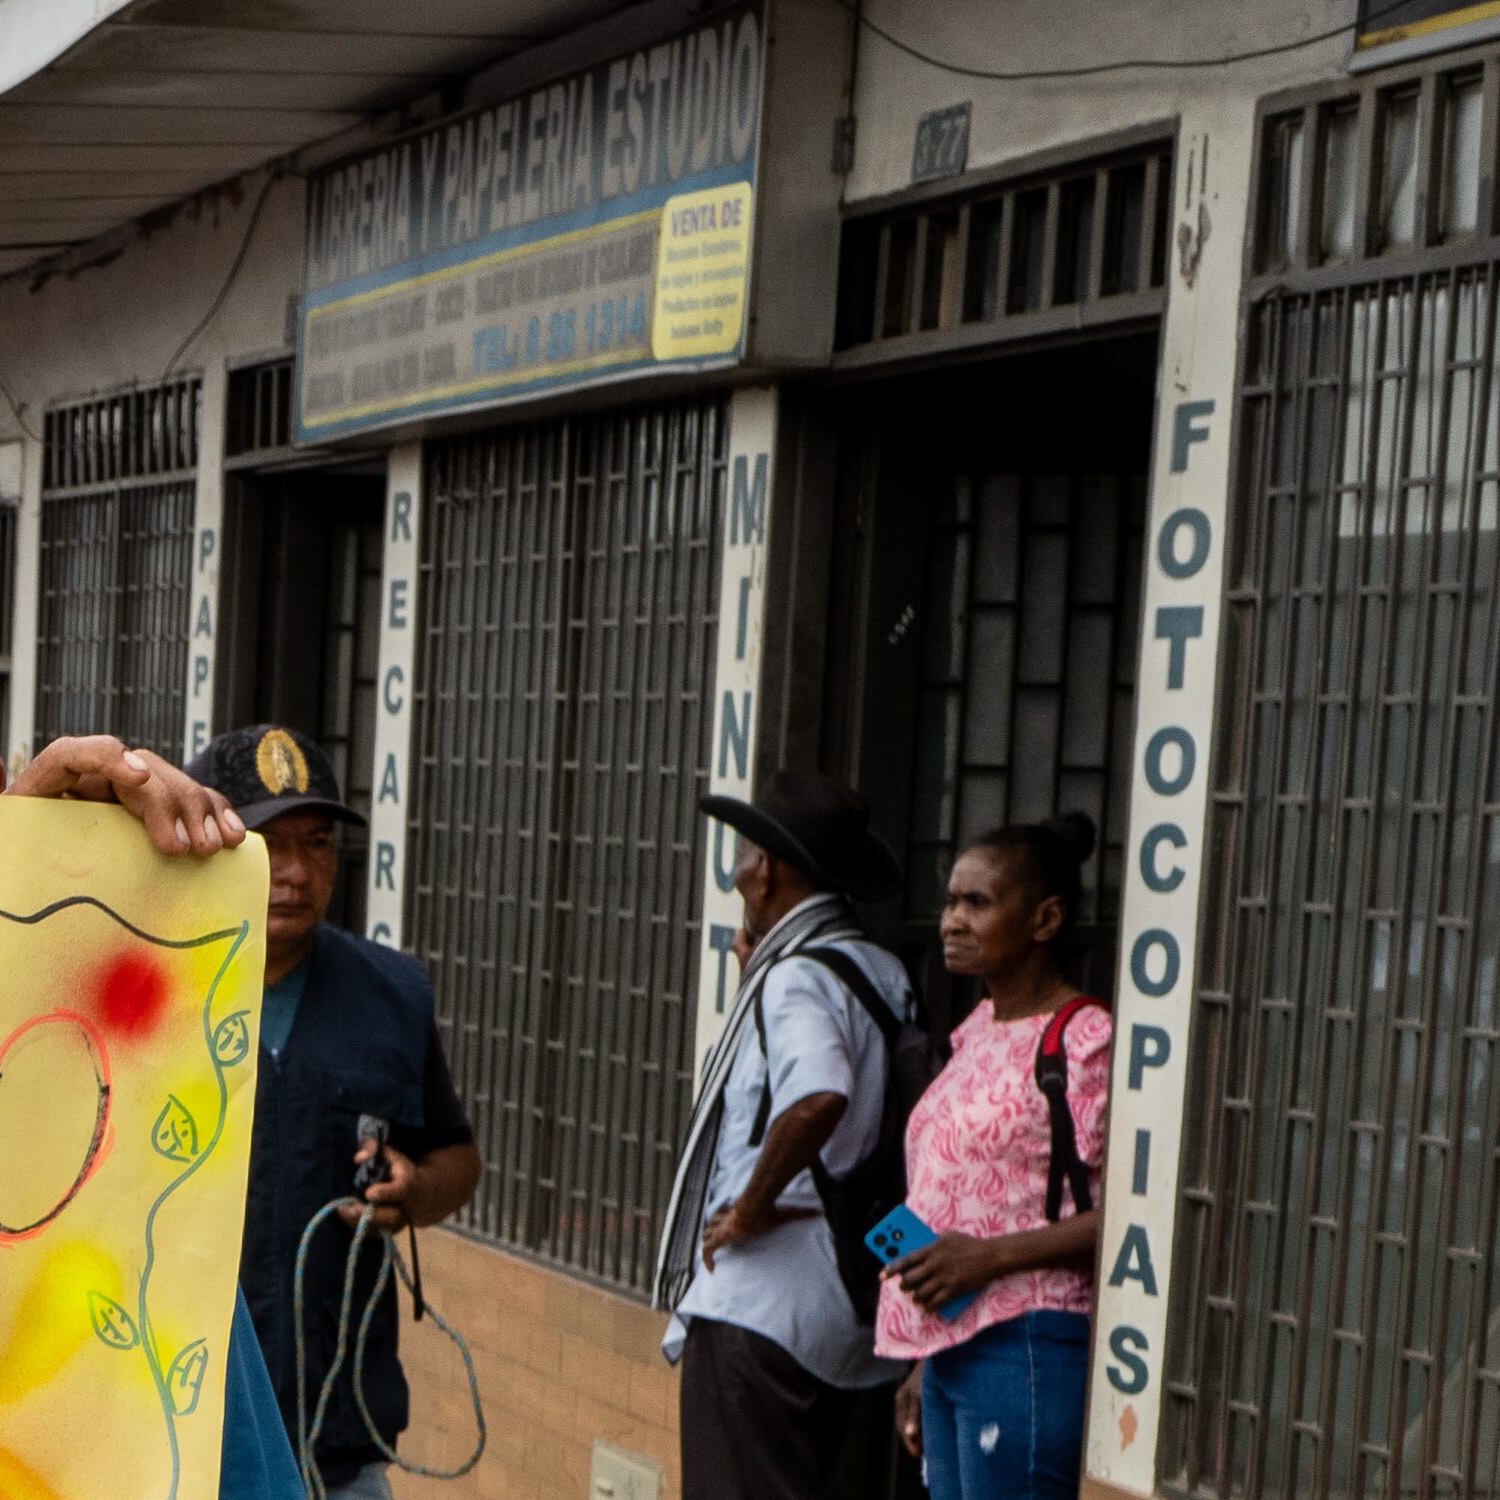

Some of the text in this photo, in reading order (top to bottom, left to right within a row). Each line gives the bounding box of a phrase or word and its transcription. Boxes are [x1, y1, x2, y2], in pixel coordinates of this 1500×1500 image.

[421, 130, 441, 257] Y
[440, 75, 595, 247] PAPELERIA
[606, 12, 760, 198] ESTUDIO
[671, 197, 743, 238] VENTA DE
[1106, 399, 1216, 1395] FOTOCOPIAS
